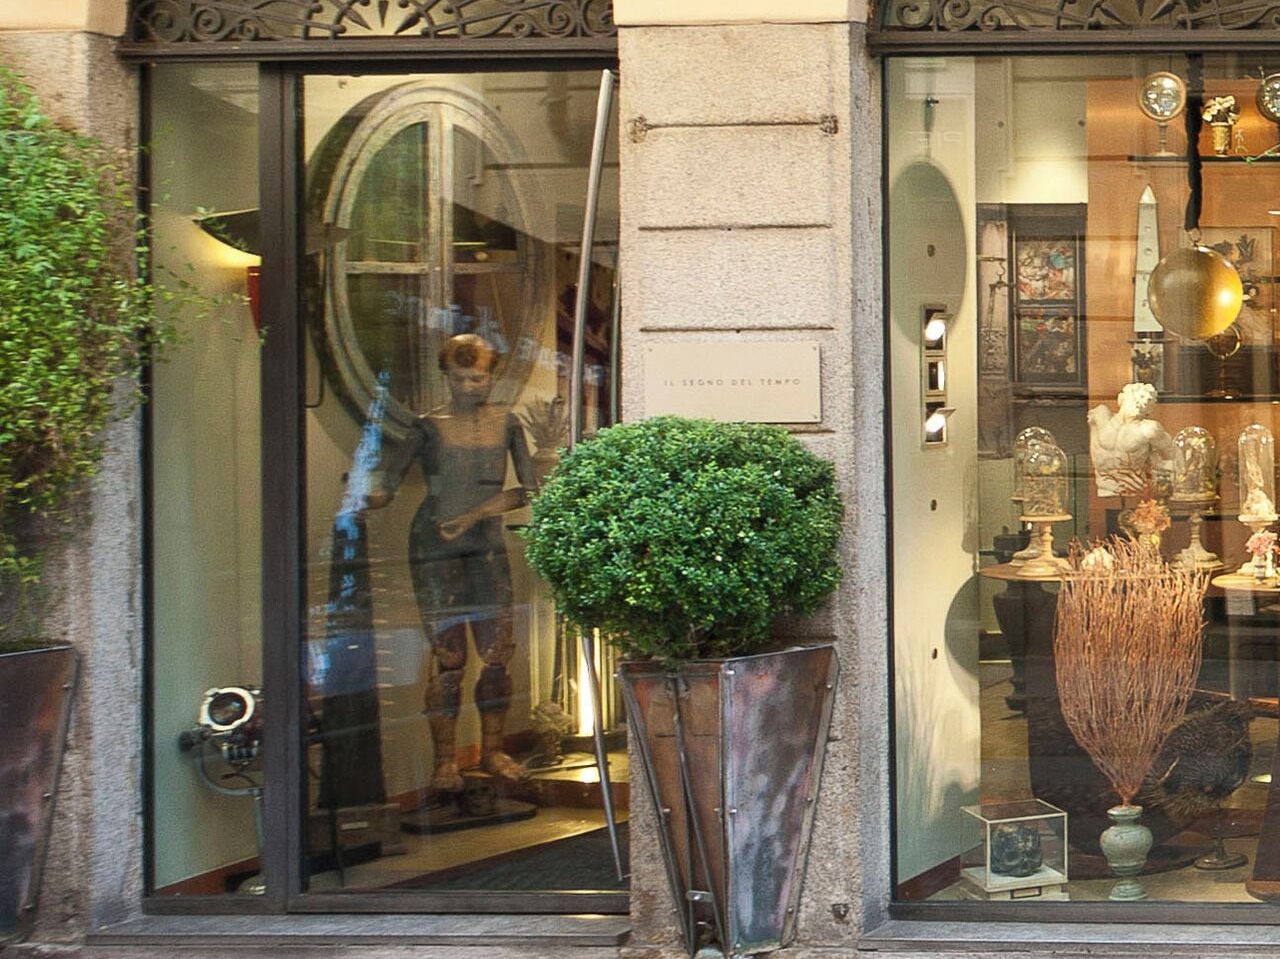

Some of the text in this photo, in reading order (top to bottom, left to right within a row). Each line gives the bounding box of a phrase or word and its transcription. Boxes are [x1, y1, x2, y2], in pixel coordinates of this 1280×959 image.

[681, 377, 725, 387] SEGNO
[731, 377, 753, 387] DEL
[759, 377, 801, 387] TEMPO
